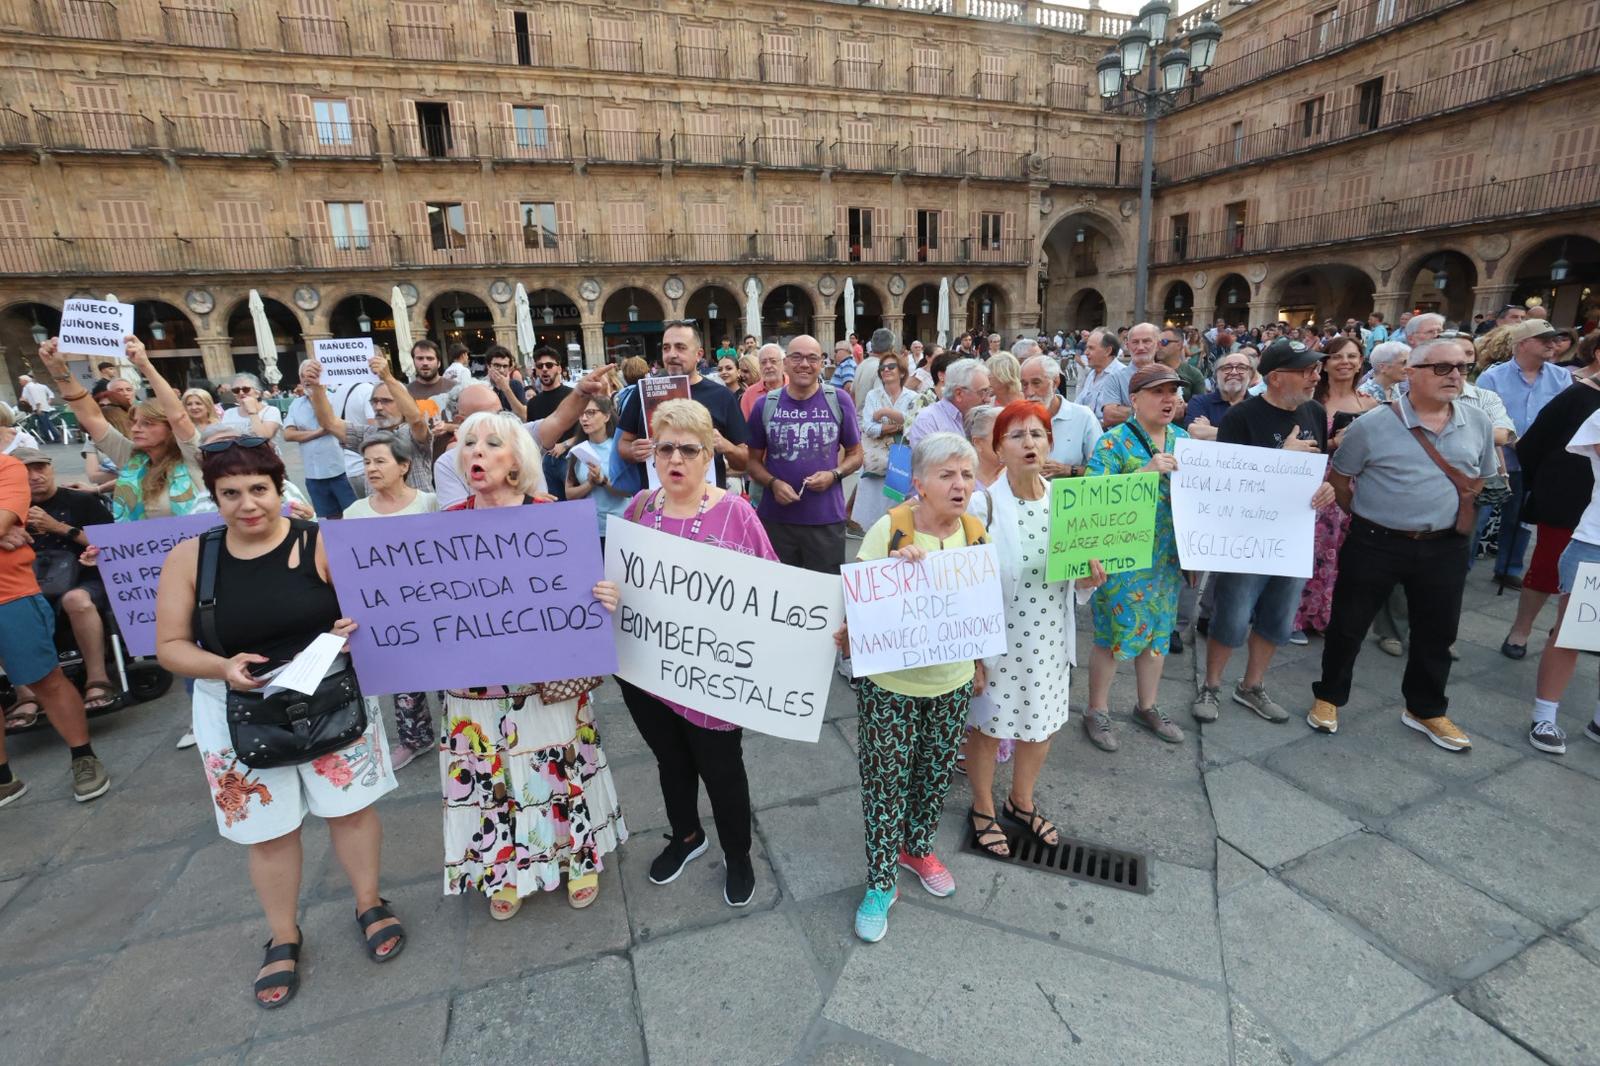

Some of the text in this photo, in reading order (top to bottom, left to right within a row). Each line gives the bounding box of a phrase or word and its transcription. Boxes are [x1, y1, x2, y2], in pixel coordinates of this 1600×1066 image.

[530, 306, 578, 318] ONALO
[773, 407, 829, 419] Made in
[1180, 447, 1211, 468] Cada
[1180, 473, 1266, 494] LLEVA LA FIRMA
[1198, 502, 1210, 514] DE
[1217, 504, 1234, 518] UN
[1066, 511, 1138, 535] MAÑUECO
[351, 529, 568, 570] LAMENTAMOS
[1181, 530, 1288, 560] NEGLIGENTE
[112, 566, 161, 584] EN PR
[842, 550, 997, 604] NUESTRA TIERRA
[1584, 575, 1600, 591] M
[118, 586, 158, 601] EXTIN
[360, 588, 390, 609] LA
[529, 575, 568, 593] DE
[620, 548, 829, 630] YO APOYO A L@S
[901, 592, 960, 622] ARDE
[1577, 602, 1600, 623] D
[370, 600, 604, 647] LOS FALLECIDOS
[620, 605, 756, 668] BOMBER@S
[661, 659, 815, 717] FORESTALES
